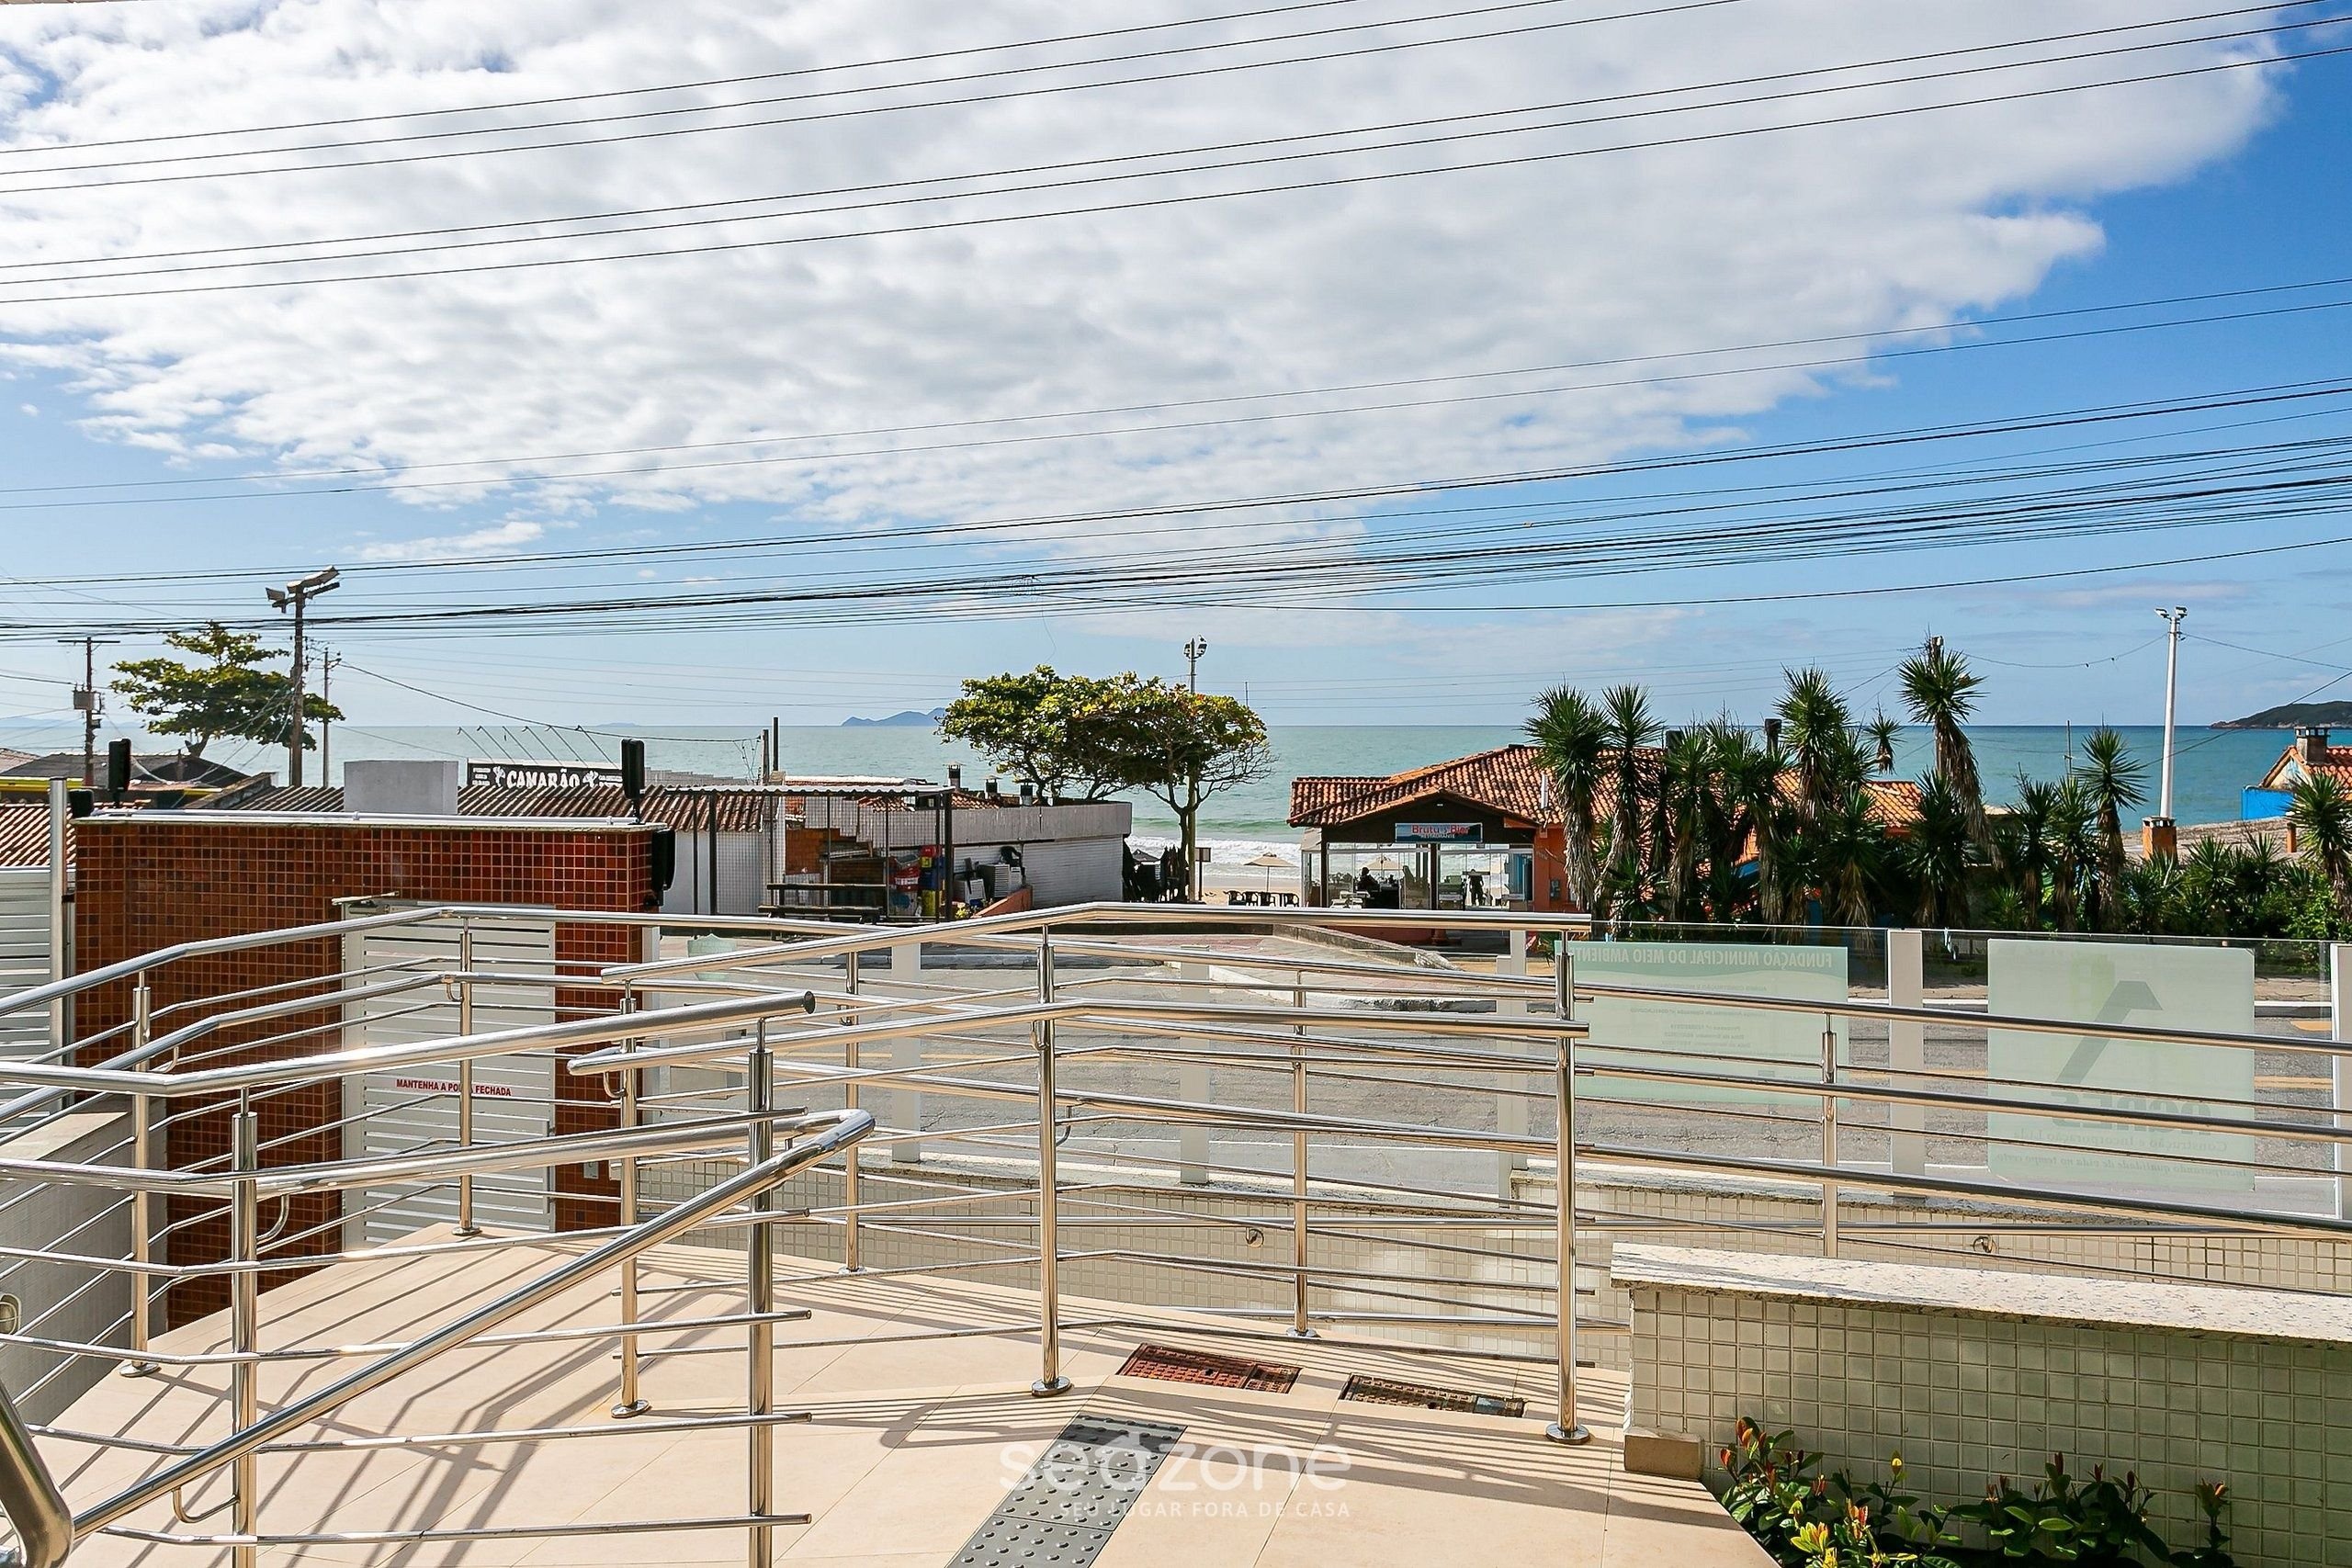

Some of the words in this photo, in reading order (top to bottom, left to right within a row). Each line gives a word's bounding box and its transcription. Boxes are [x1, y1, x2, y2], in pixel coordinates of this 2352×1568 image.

[396, 1078, 439, 1091] MANTENHA
[440, 1082, 447, 1091] A
[475, 1085, 512, 1097] FECHADA
